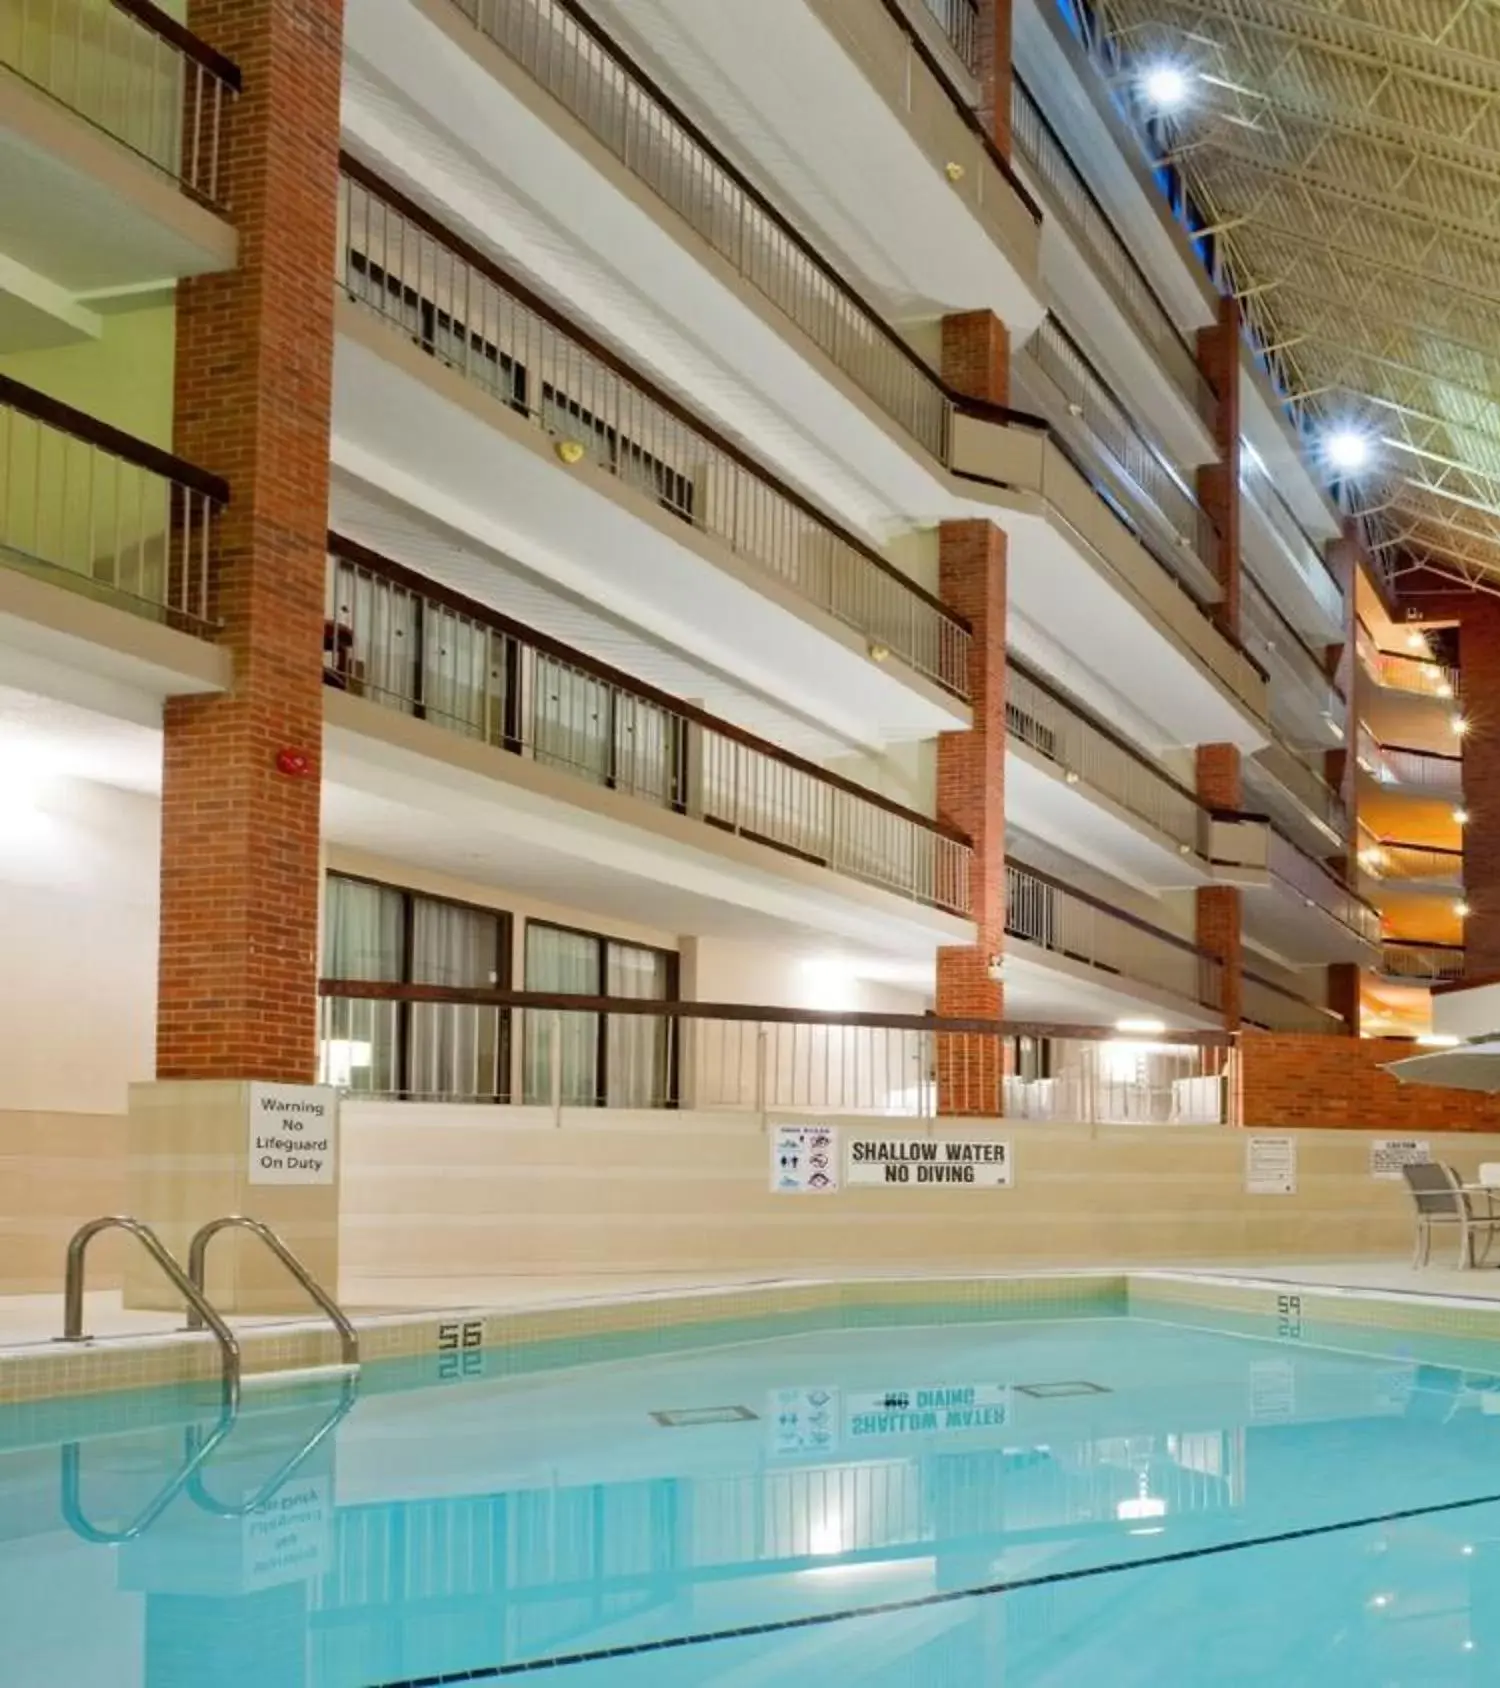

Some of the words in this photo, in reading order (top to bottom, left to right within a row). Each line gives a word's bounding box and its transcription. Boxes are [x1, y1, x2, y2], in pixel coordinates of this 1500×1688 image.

[261, 1098, 325, 1117] Warning
[282, 1119, 304, 1131] No
[256, 1136, 328, 1152] Lifeguard
[852, 1142, 937, 1161] SHALLOW
[946, 1144, 1005, 1162] WATER
[261, 1155, 284, 1169] On
[287, 1157, 323, 1172] Duty
[885, 1165, 909, 1182] NO
[917, 1164, 975, 1183] DIVING
[439, 1322, 482, 1350] 56
